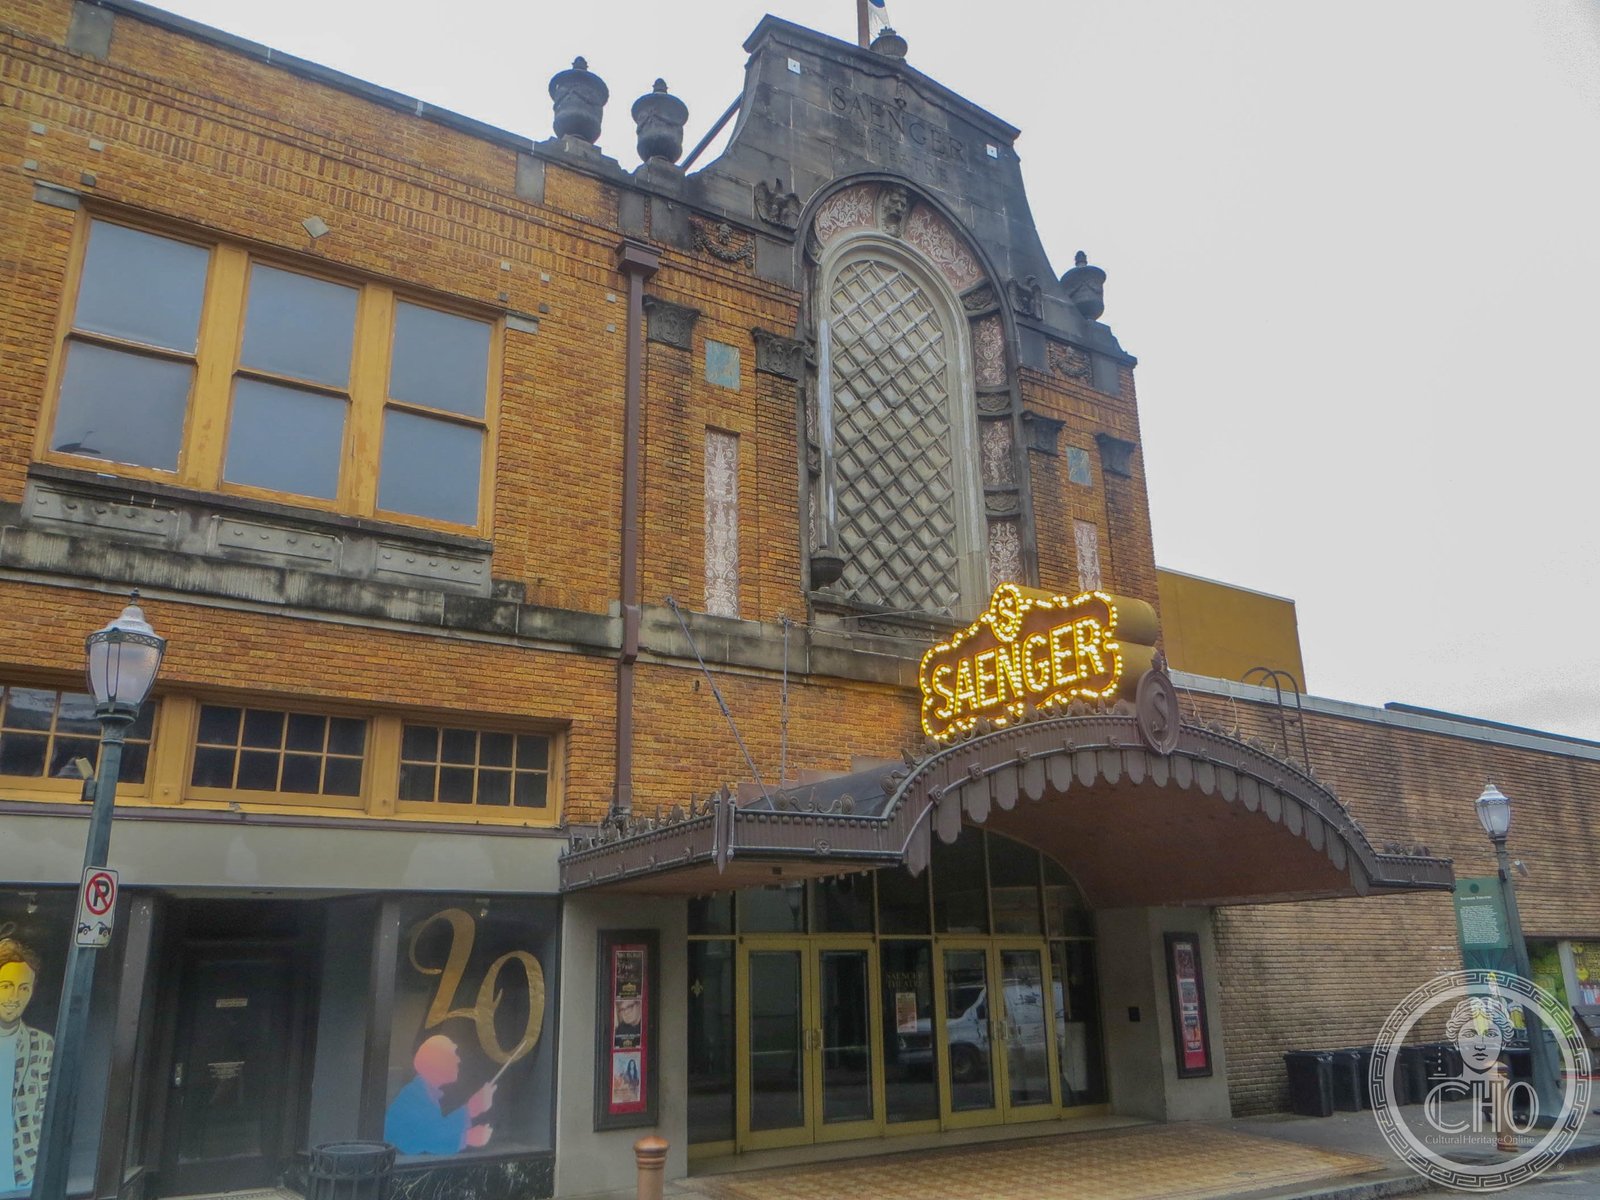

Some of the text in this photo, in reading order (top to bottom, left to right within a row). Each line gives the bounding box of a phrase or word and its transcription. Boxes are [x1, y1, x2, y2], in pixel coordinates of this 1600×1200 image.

[832, 86, 967, 163] SAENGER
[855, 128, 949, 184] HEATRE
[932, 615, 1106, 719] SAENGER
